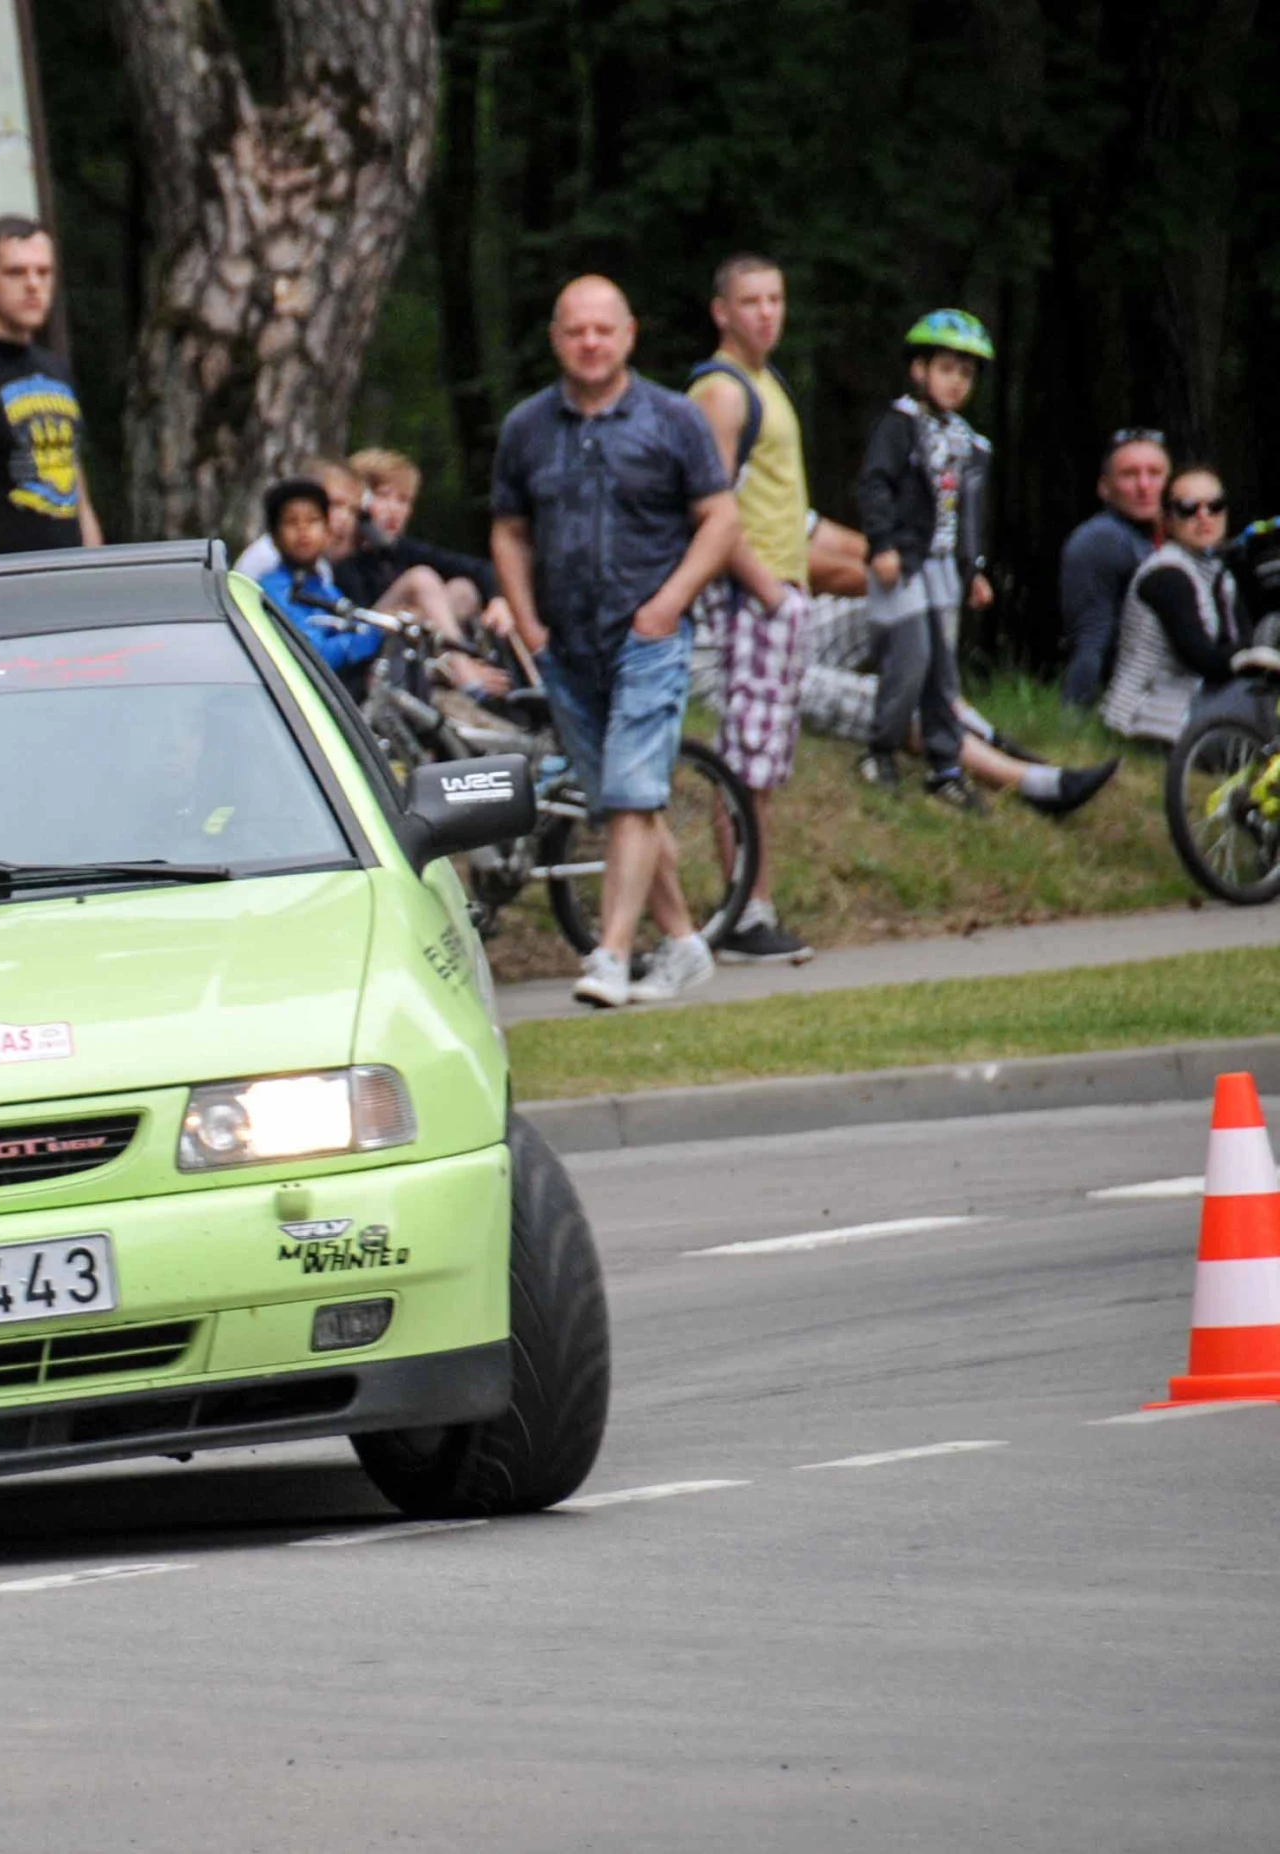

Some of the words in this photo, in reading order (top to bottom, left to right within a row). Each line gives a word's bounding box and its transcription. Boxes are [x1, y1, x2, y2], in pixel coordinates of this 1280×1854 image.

[441, 771, 513, 792] WRC
[277, 1238, 353, 1261] MOST
[302, 1247, 411, 1274] WANTED
